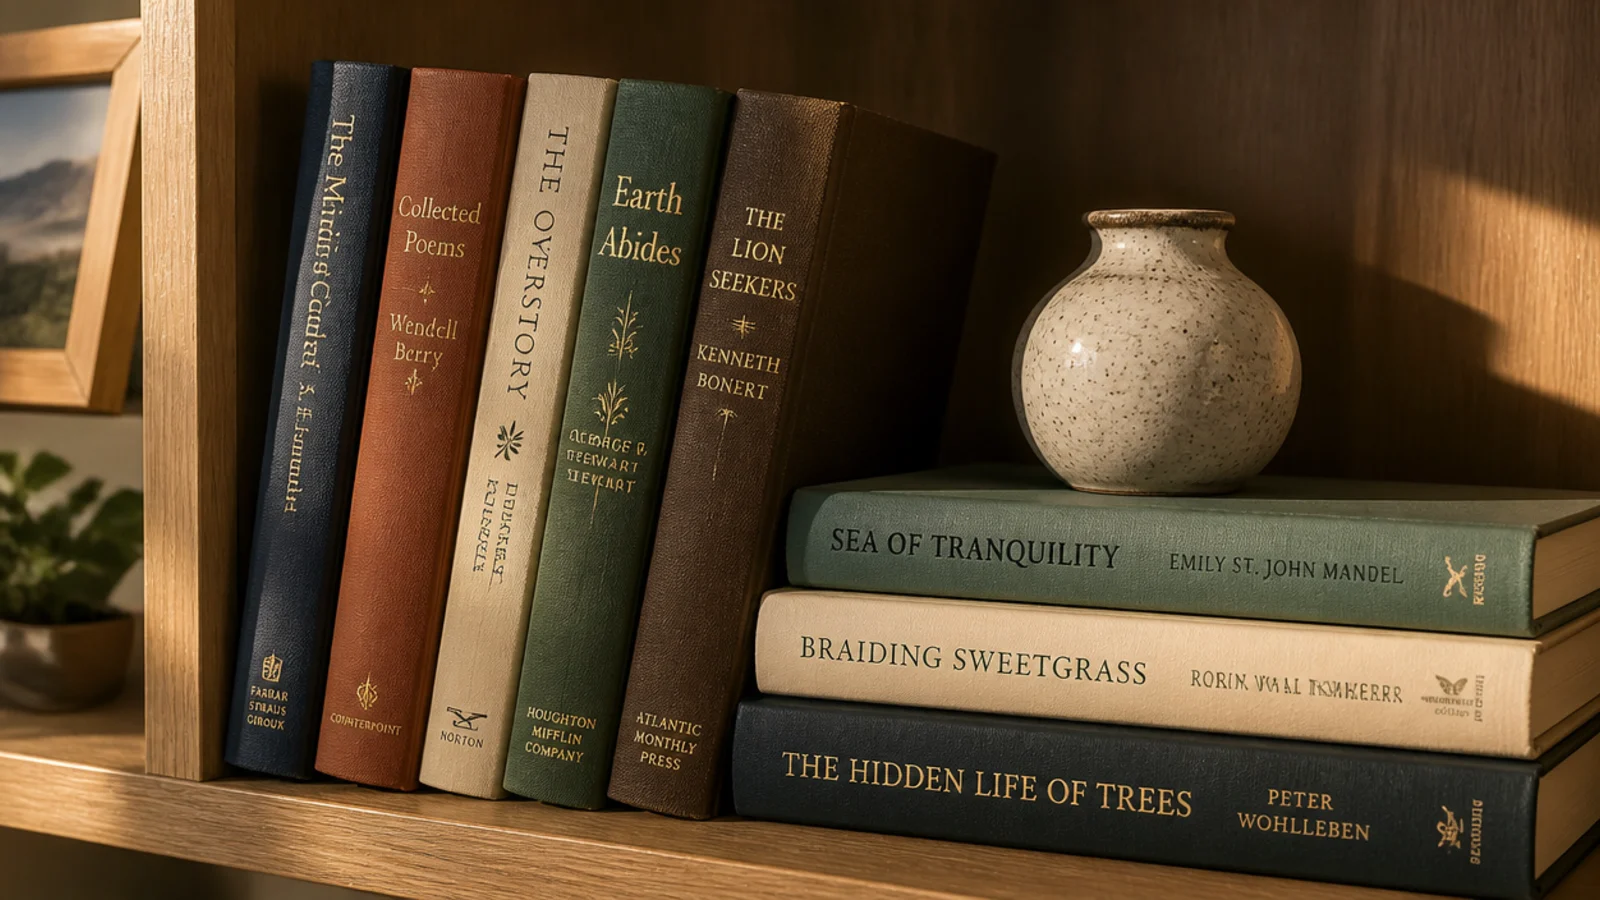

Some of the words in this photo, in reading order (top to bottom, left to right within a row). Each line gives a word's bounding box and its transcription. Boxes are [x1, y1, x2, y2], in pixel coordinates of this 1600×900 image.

[327, 115, 355, 167] The
[539, 127, 569, 193] THE
[612, 175, 682, 215] Earth
[399, 195, 482, 225] Collected
[745, 206, 786, 231] THE
[404, 230, 465, 258] Poems
[598, 226, 682, 266] Abides
[731, 237, 787, 265] LION
[709, 269, 797, 301] SEEKERS
[507, 210, 555, 400] OVERSTORY
[696, 343, 781, 374] KENNETH
[696, 372, 769, 400] BONERT
[831, 528, 878, 554] SEA
[887, 532, 923, 556] OF
[930, 534, 1120, 569] TRANQUILITY
[1169, 553, 1227, 573] EMILY
[1232, 556, 1260, 576] ST.
[1262, 559, 1316, 580] JOHN
[1322, 563, 1404, 584] MANDEL
[800, 635, 942, 669] BRAIDING
[953, 647, 1146, 685] SWEETGRASS
[527, 706, 597, 730] HOUGHTON
[636, 711, 702, 737] ATLANTIC
[440, 730, 484, 748] NORTON
[532, 725, 582, 745] MIFFLIN
[634, 730, 697, 755] MONTHLY
[525, 741, 584, 763] COMPANY
[640, 751, 681, 771] PRESS
[782, 751, 839, 781] THE
[849, 758, 965, 794] HIDDEN
[974, 771, 1038, 801] LIFE
[1047, 778, 1088, 806] OF
[1096, 782, 1192, 818] TREES
[1267, 789, 1334, 811] PETER
[1237, 812, 1370, 841] WOHLLEBEN
